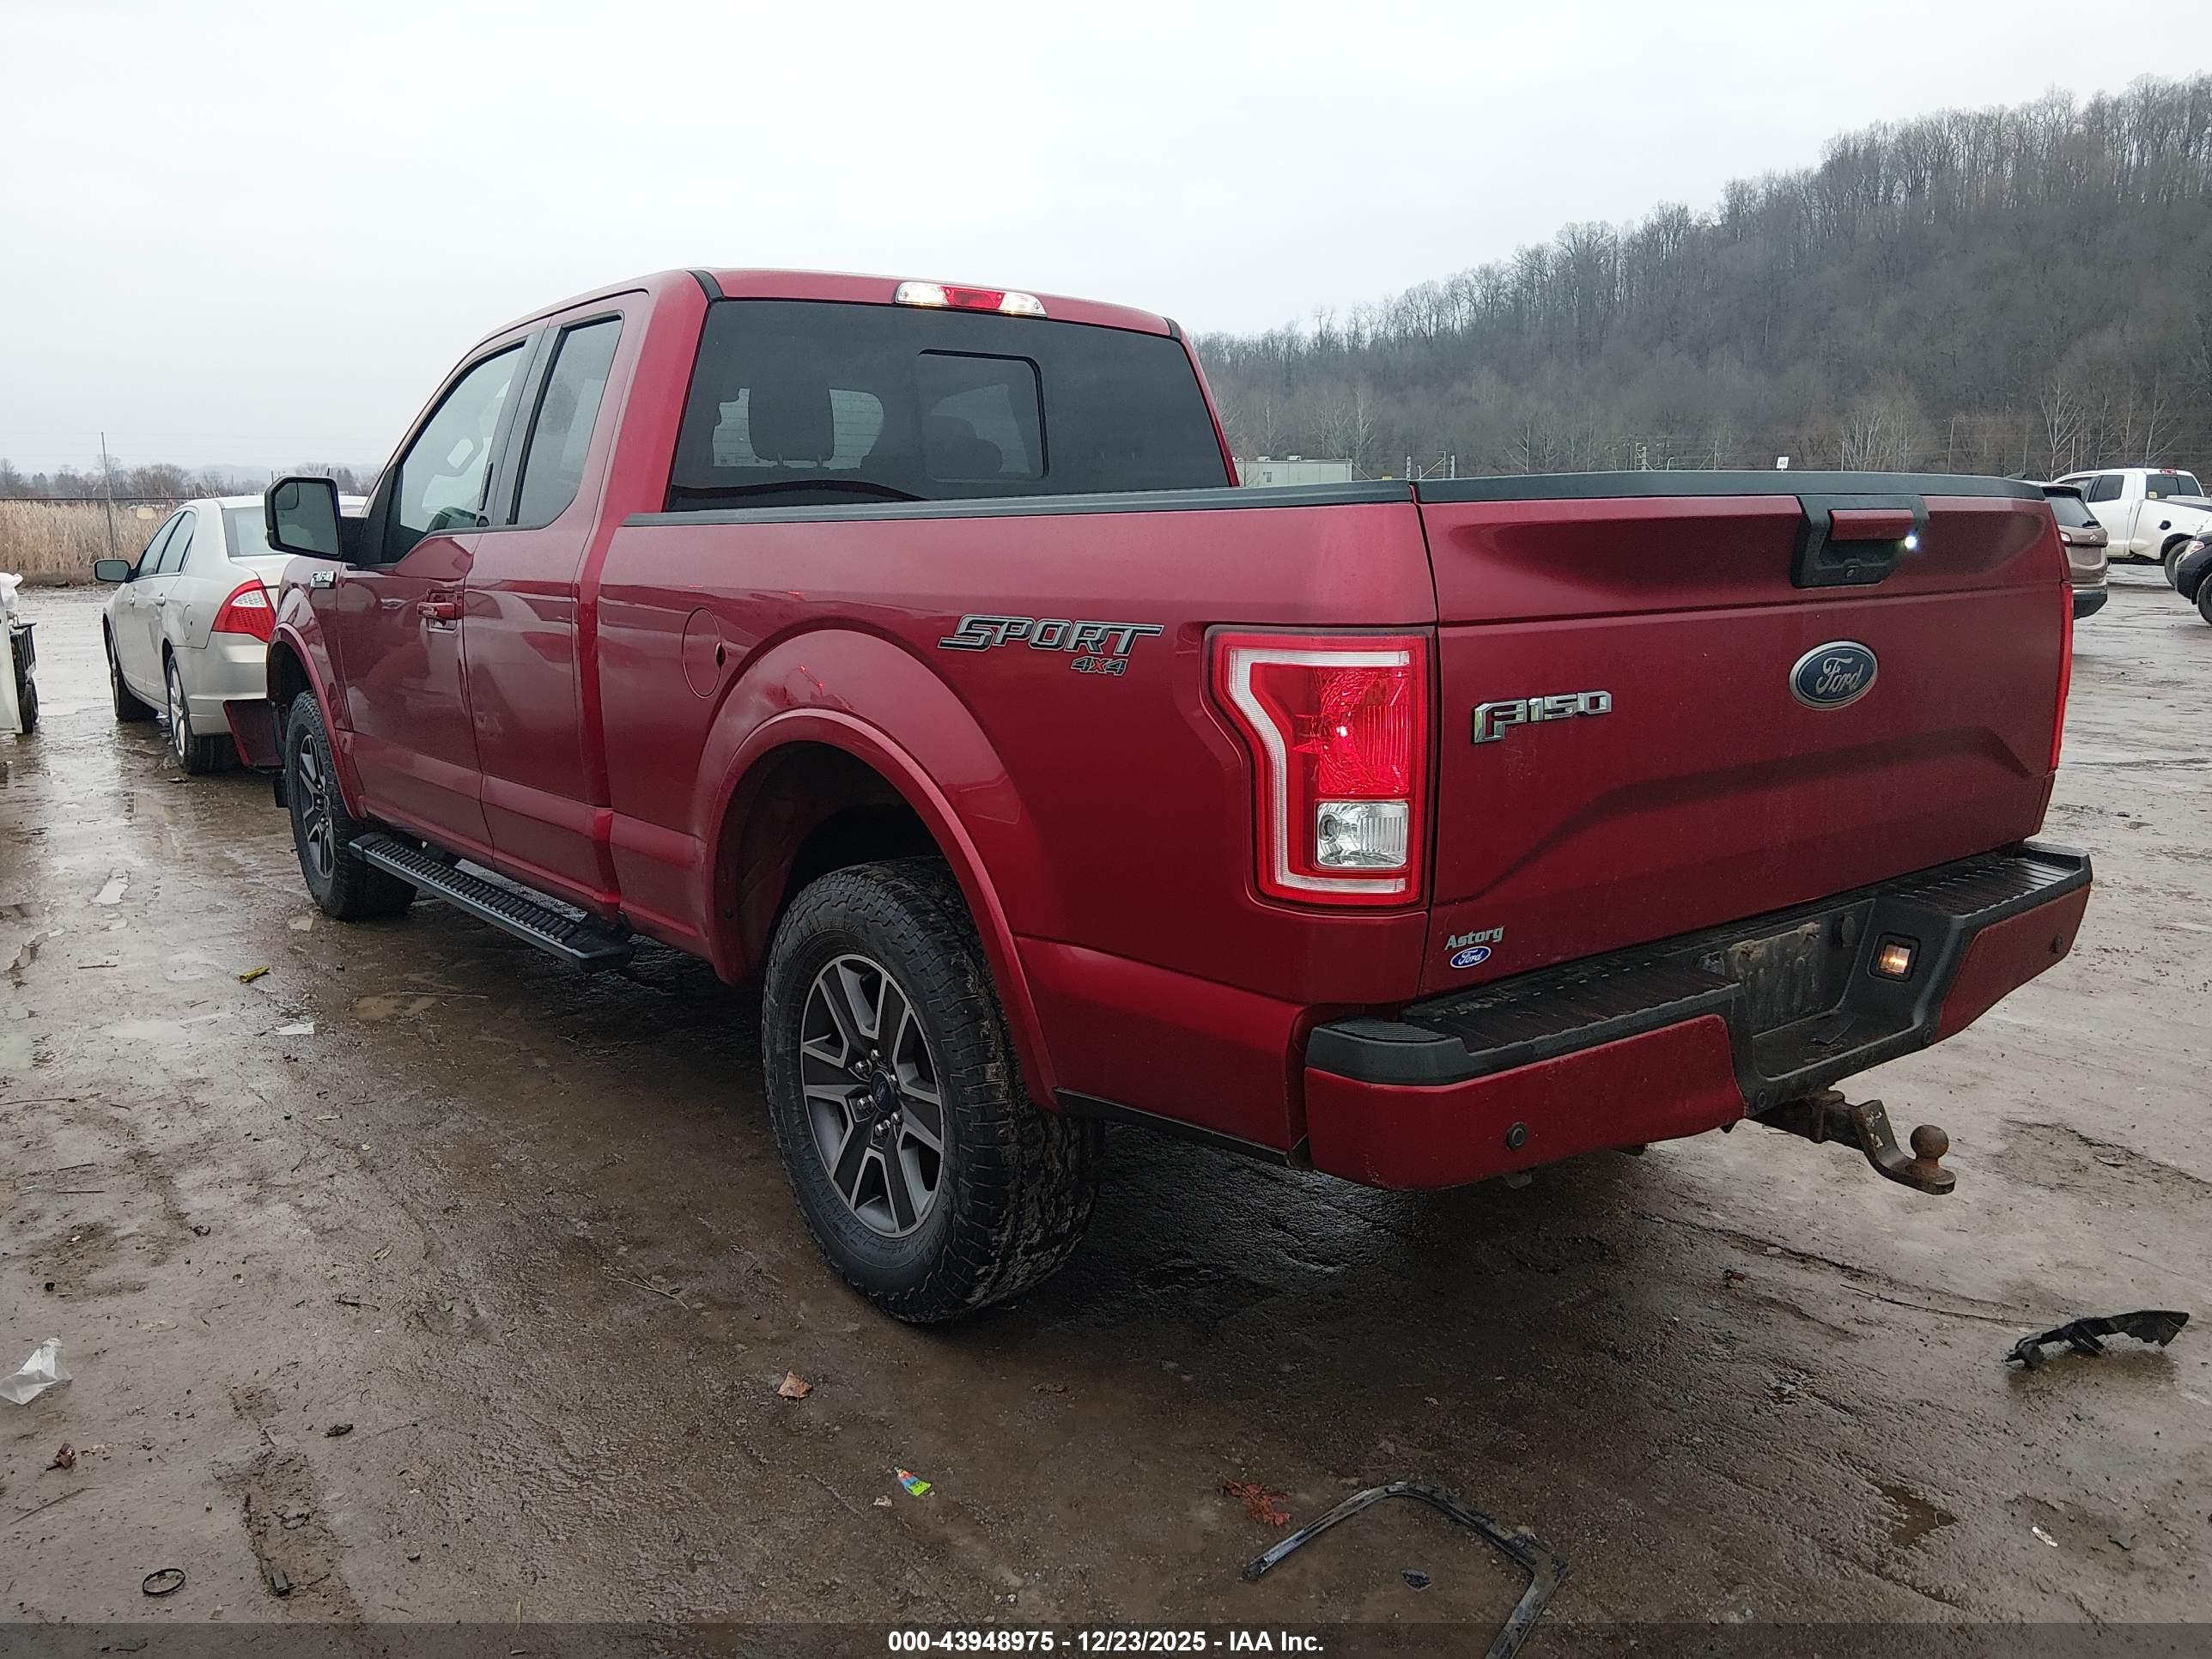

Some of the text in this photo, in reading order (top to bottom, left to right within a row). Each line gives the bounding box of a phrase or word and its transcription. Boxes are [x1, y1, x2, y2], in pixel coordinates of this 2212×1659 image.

[938, 614, 1164, 656] SPORT
[1815, 657, 1864, 695] Ford
[1473, 690, 1613, 744] F150
[1443, 926, 1505, 951] Astorg
[1458, 948, 1485, 965] Ford
